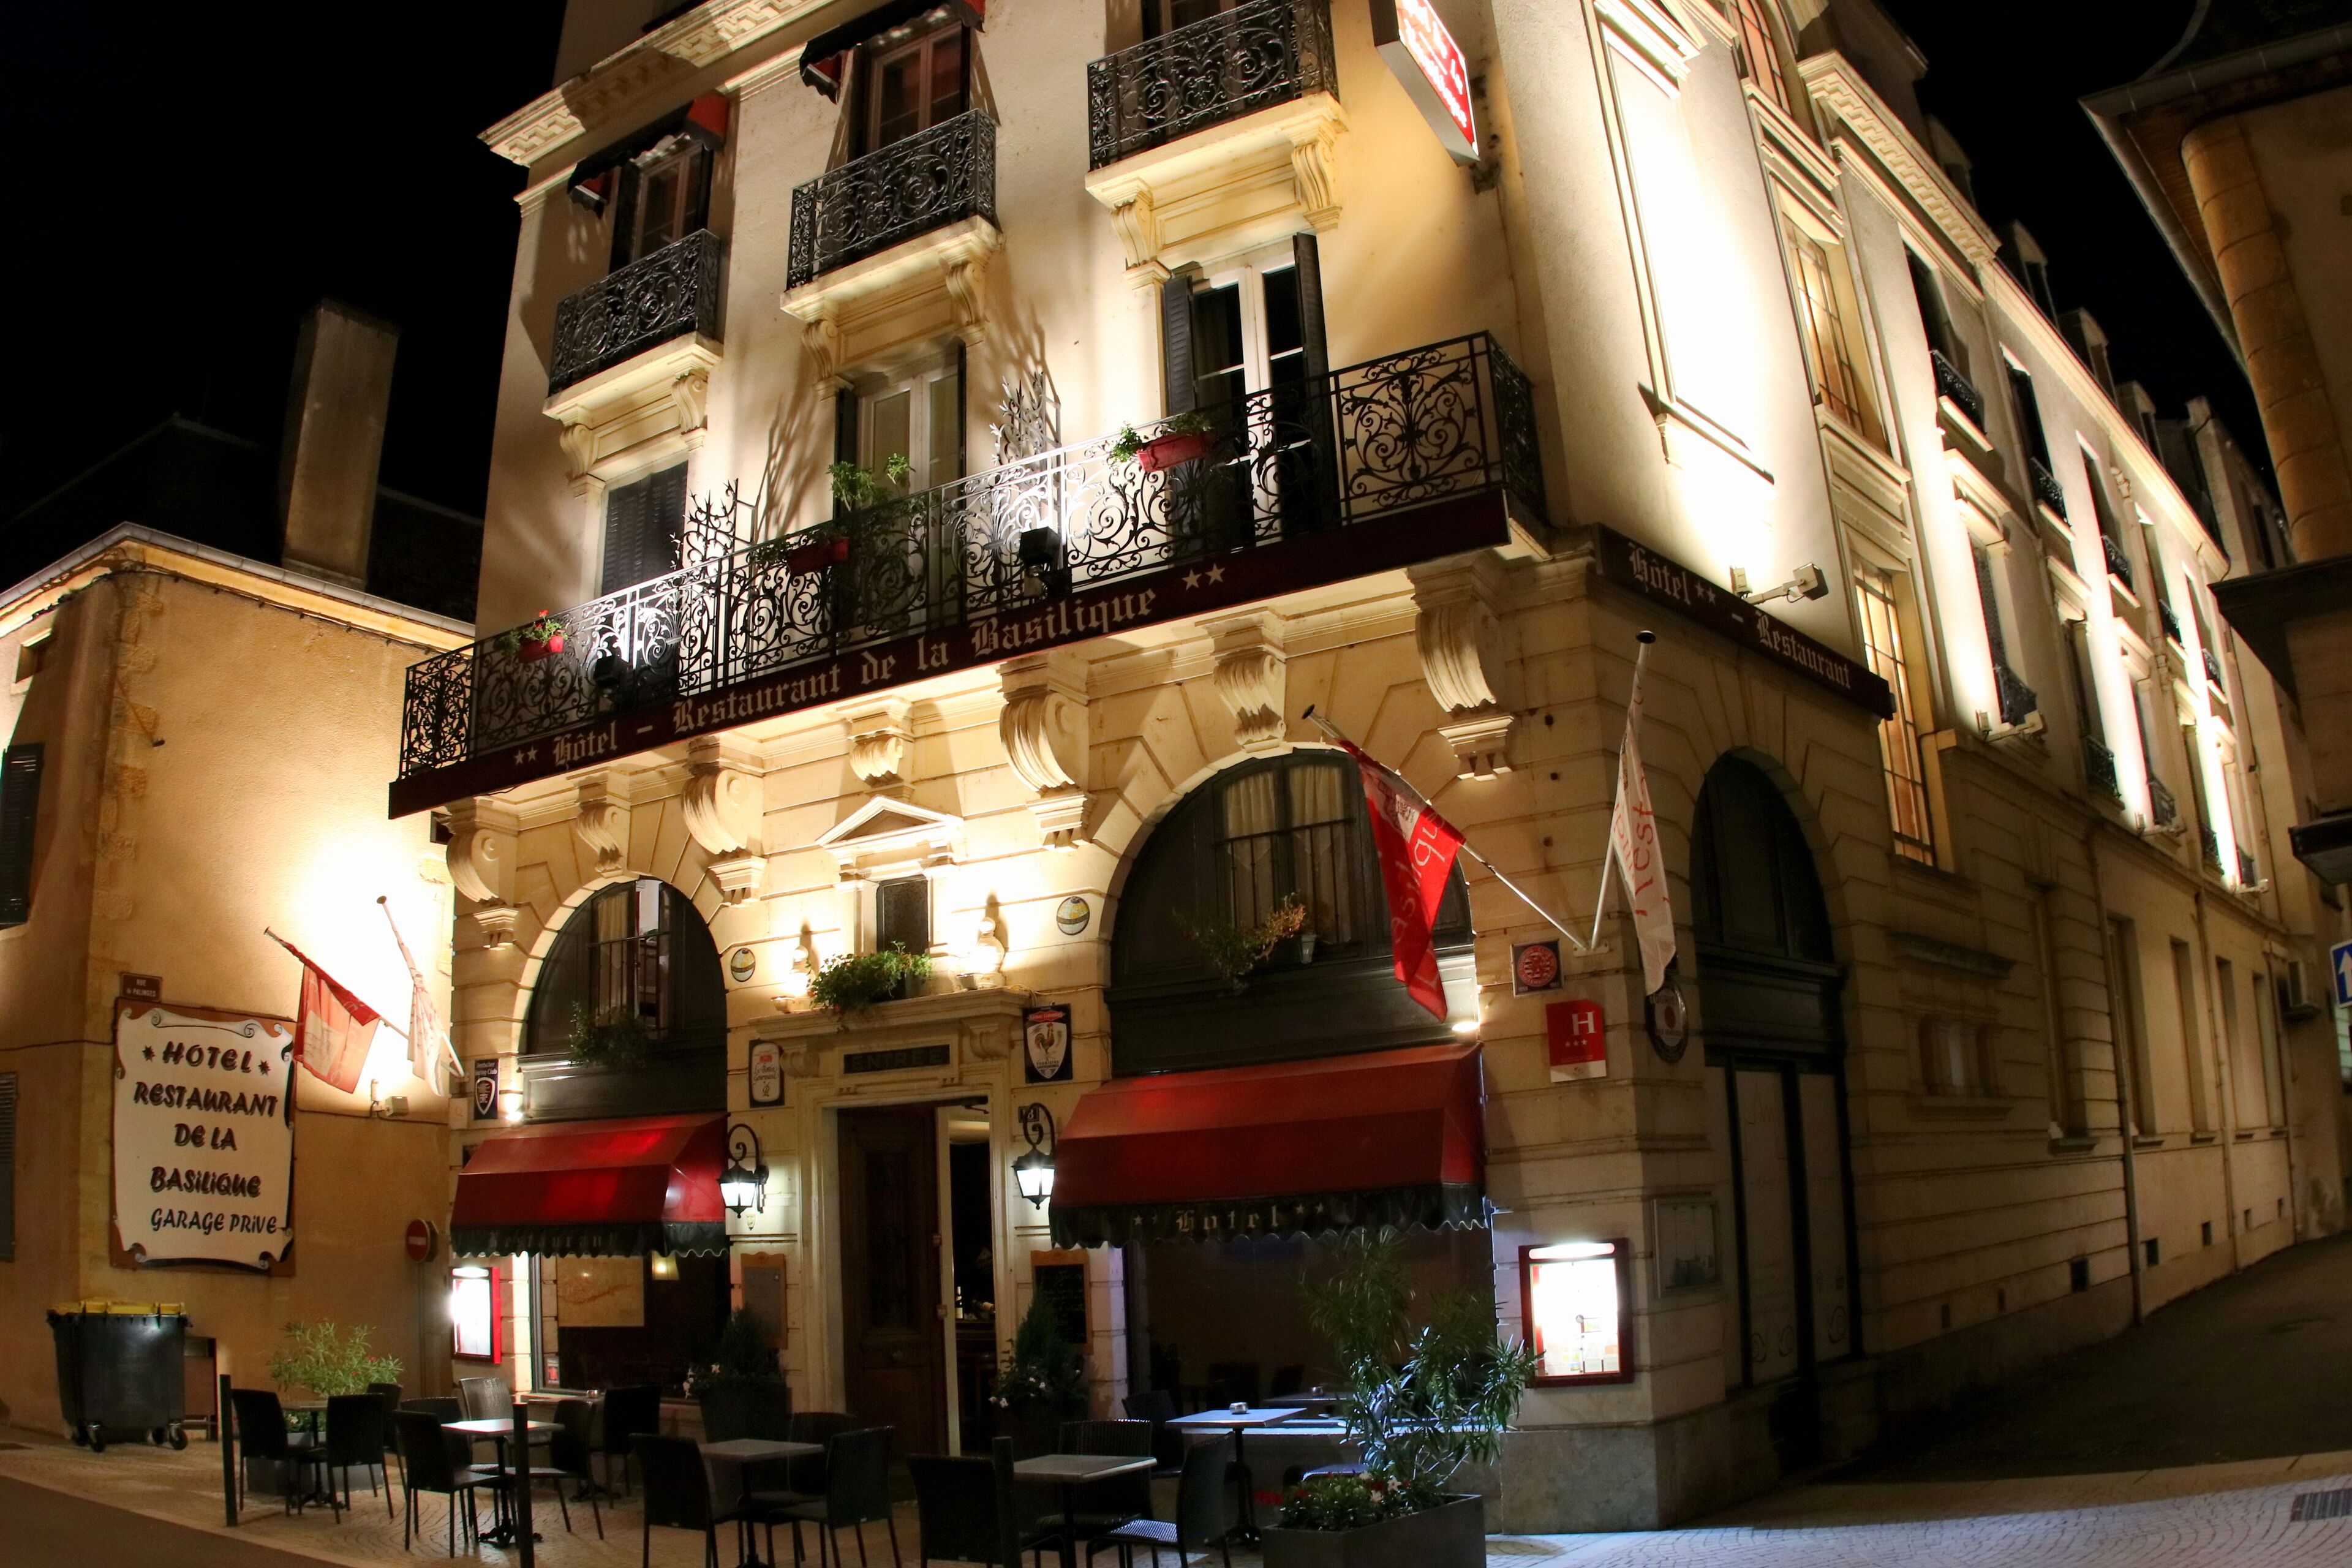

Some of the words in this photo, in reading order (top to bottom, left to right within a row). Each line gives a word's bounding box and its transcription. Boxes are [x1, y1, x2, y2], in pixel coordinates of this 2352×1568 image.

[1755, 609, 1851, 690] Restaurant
[552, 719, 618, 771] Hôtel
[673, 665, 840, 734] Restaurant
[861, 650, 897, 685] de
[917, 635, 950, 671] la
[969, 587, 1156, 658] Basilique
[1571, 1011, 1597, 1036] H
[133, 1081, 278, 1117] RESTAURANT
[174, 1123, 205, 1148] DE
[211, 1126, 238, 1152] LA
[151, 1208, 224, 1235] GARAGE
